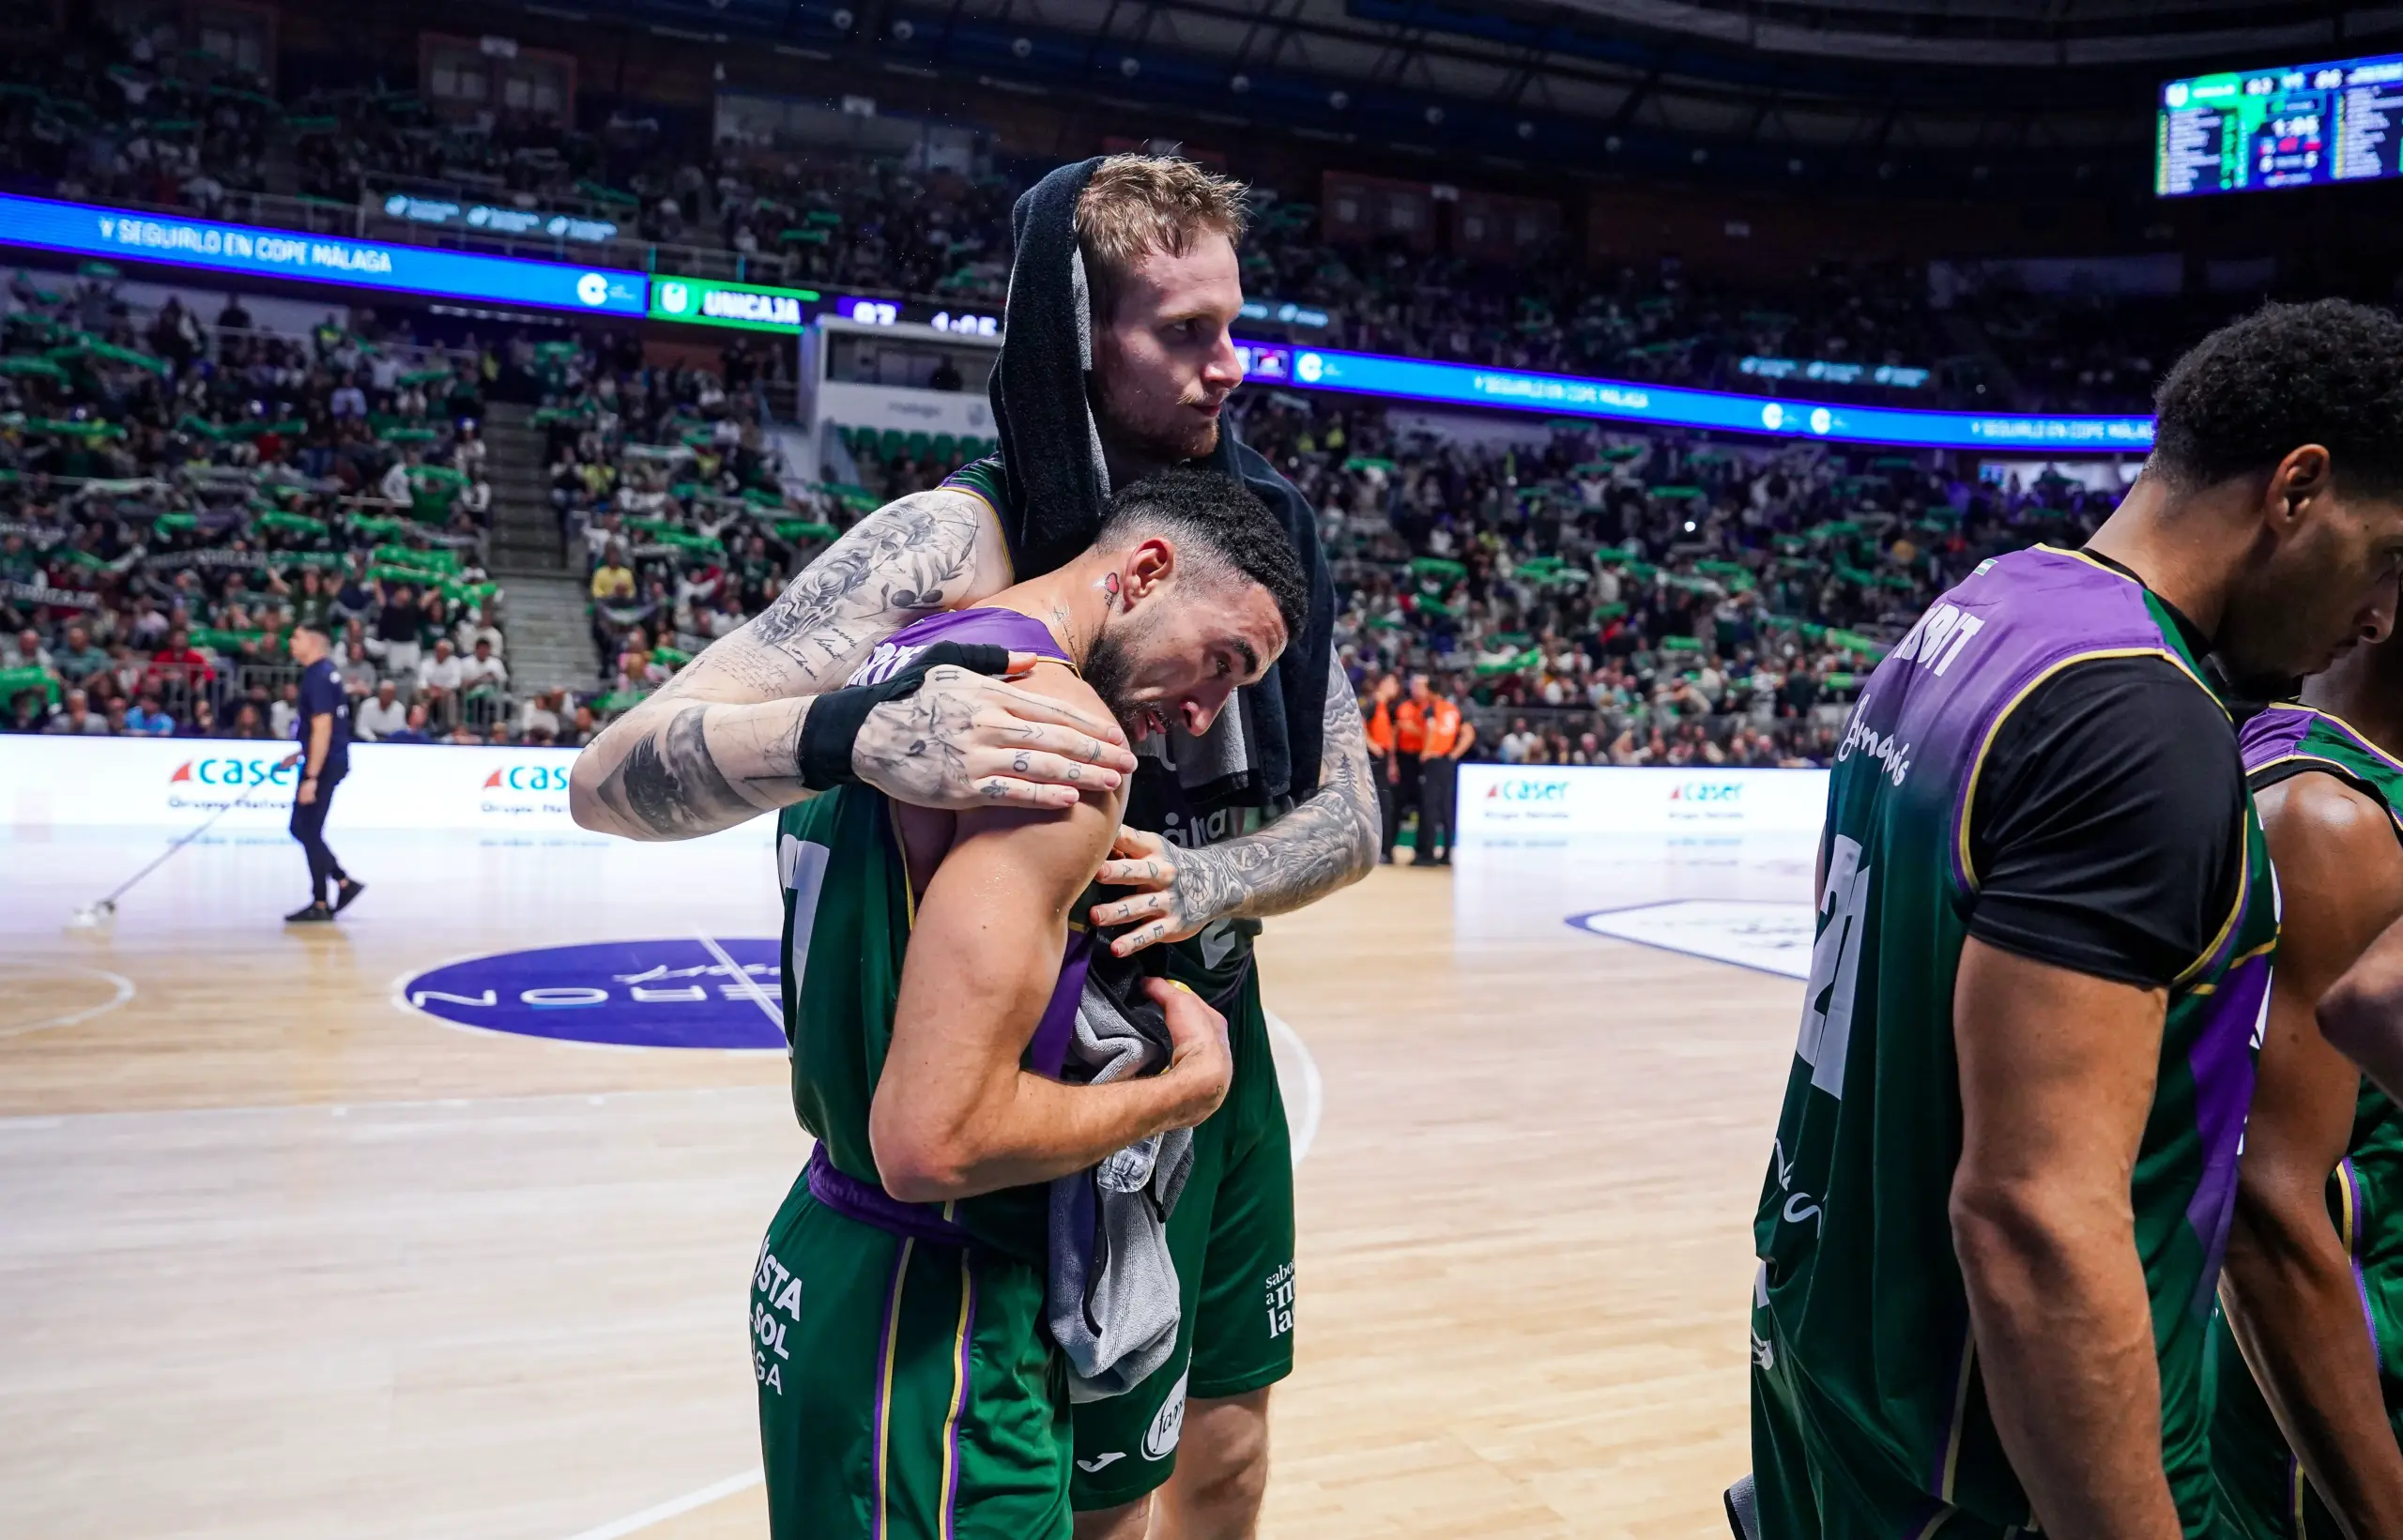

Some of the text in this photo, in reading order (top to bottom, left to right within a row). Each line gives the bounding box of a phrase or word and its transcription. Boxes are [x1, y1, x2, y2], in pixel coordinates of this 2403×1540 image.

[117, 219, 222, 255] SEGUIRLO
[223, 233, 253, 258] EN
[255, 236, 307, 266] COPE
[312, 242, 391, 273] MÁLAGA
[703, 290, 801, 325] UNICAJA
[509, 765, 568, 790] cas
[1503, 780, 1569, 800] caser
[1685, 781, 1743, 801] caser
[1796, 833, 1869, 1100] 21
[754, 1235, 802, 1321] STA
[1265, 1274, 1295, 1309] a m
[754, 1302, 789, 1360] SOL
[1266, 1304, 1294, 1339] la
